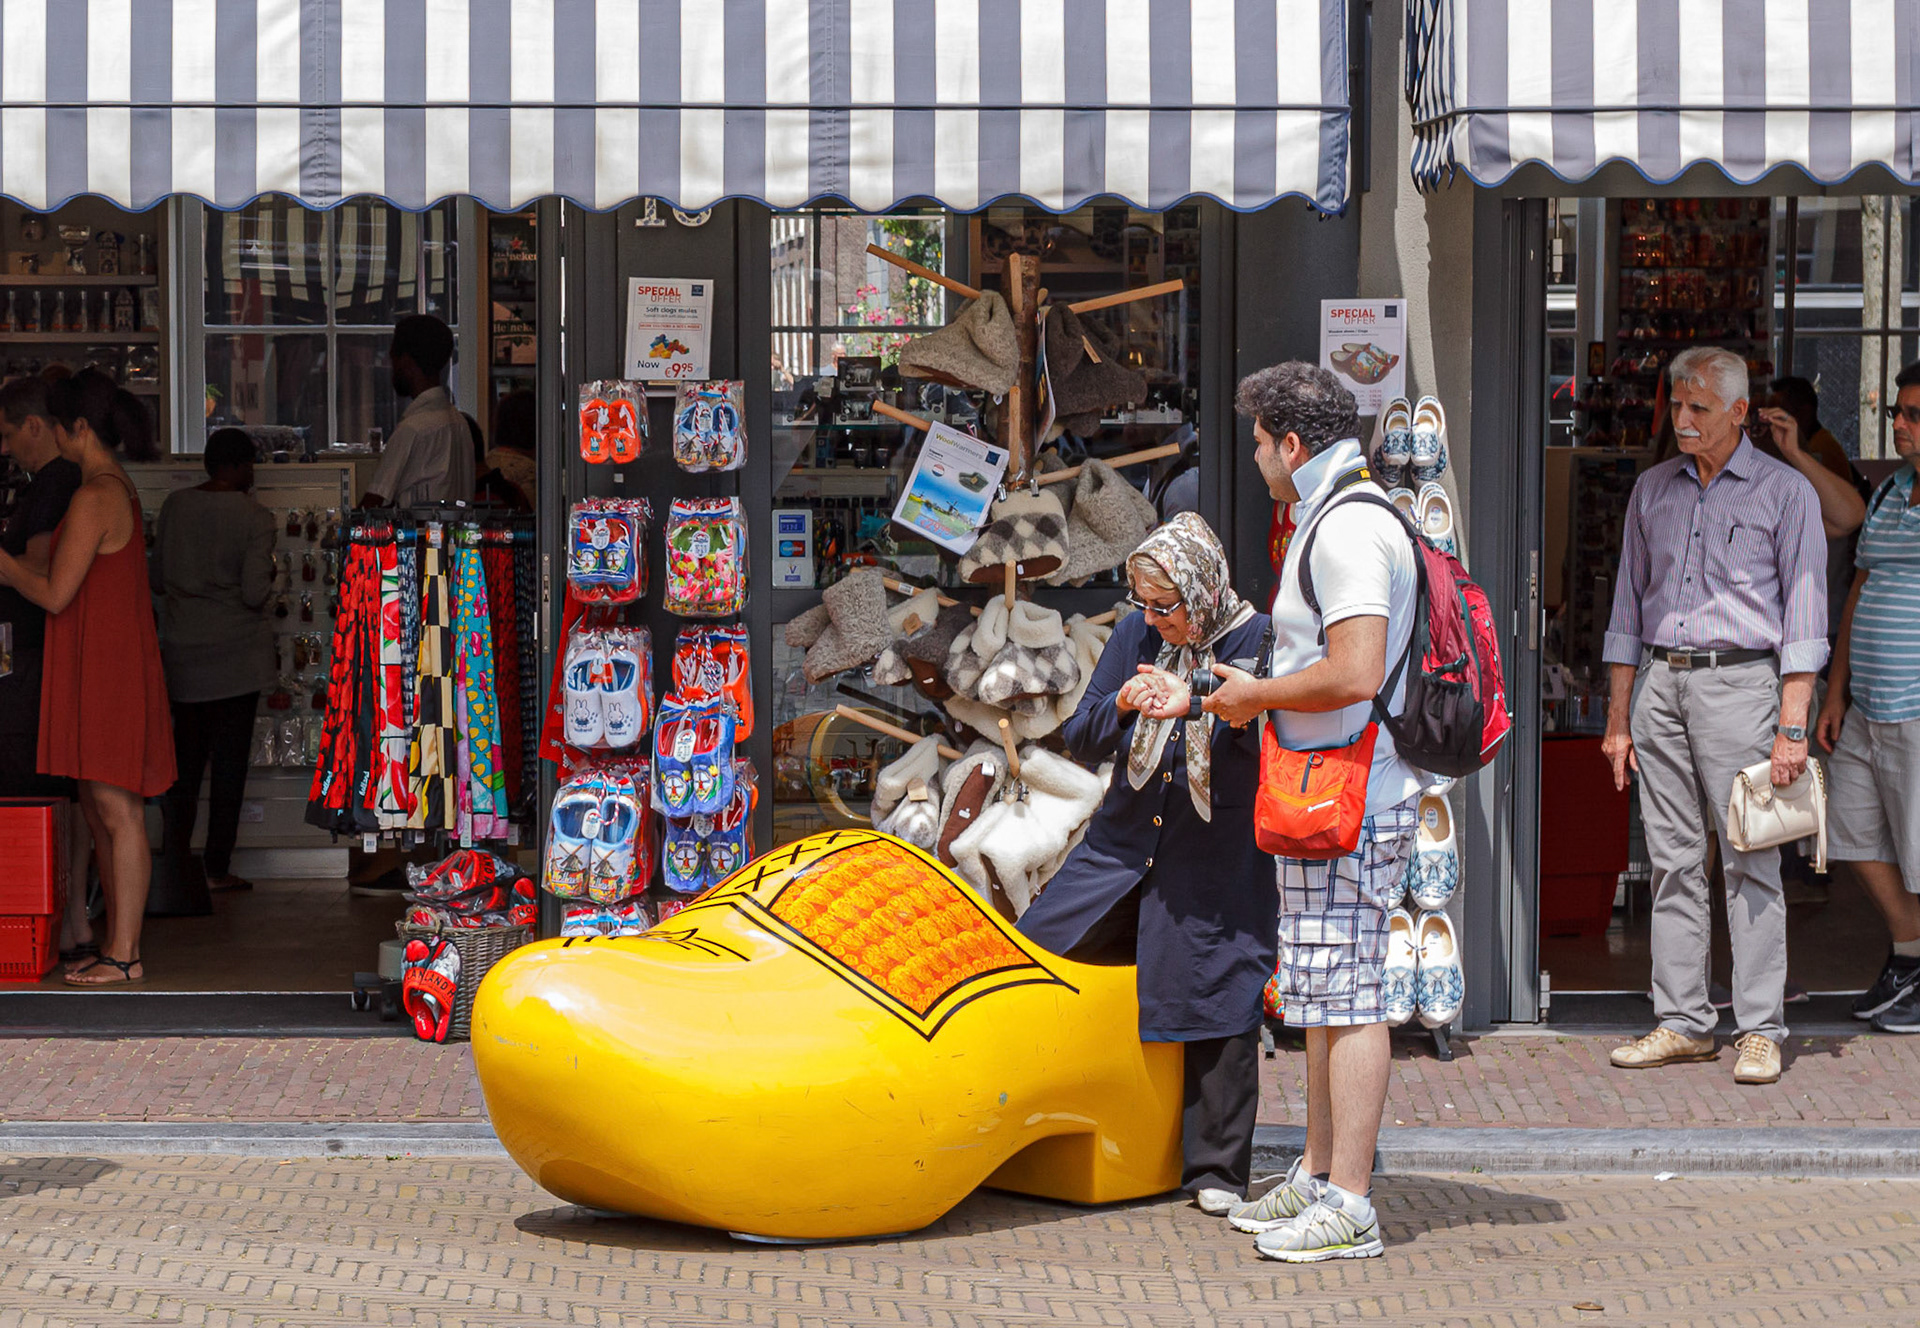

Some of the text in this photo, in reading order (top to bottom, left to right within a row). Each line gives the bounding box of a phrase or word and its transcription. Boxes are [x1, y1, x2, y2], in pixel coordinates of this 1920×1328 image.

[638, 286, 682, 297] SPECIAL
[650, 295, 682, 303] OFFER
[660, 306, 677, 315] clogs
[1330, 308, 1376, 317] SPECIAL
[1344, 316, 1376, 325] OFFER
[637, 360, 694, 378] Now €9.95
[935, 432, 983, 460] WoolWarmers
